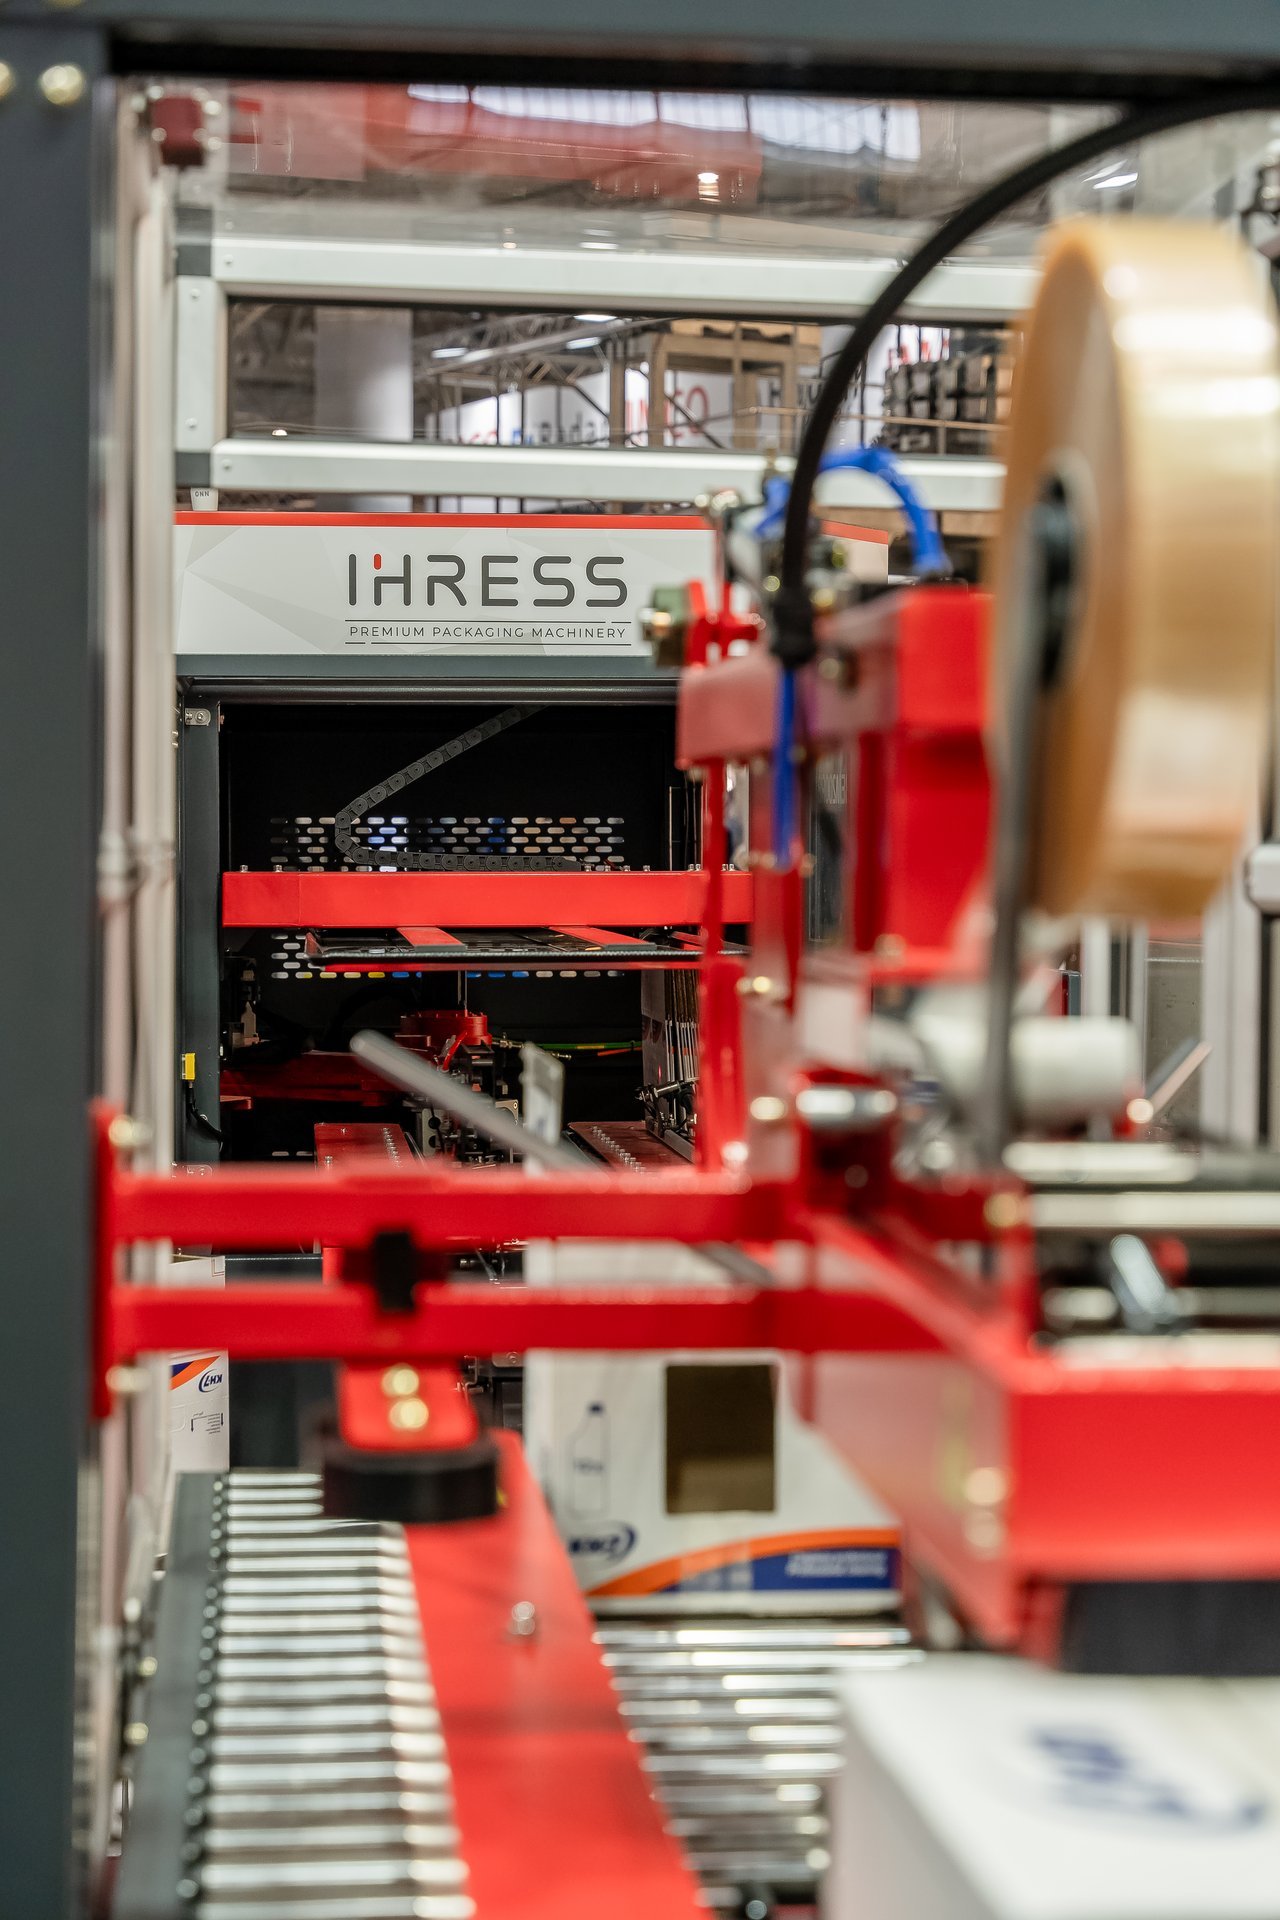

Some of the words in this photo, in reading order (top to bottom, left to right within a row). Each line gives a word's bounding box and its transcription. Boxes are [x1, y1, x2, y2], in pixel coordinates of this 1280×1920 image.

[348, 553, 628, 607] IHRESS
[349, 626, 425, 637] PREMIUM
[432, 626, 524, 638] PACKAGING
[532, 627, 626, 639] MACHINERY
